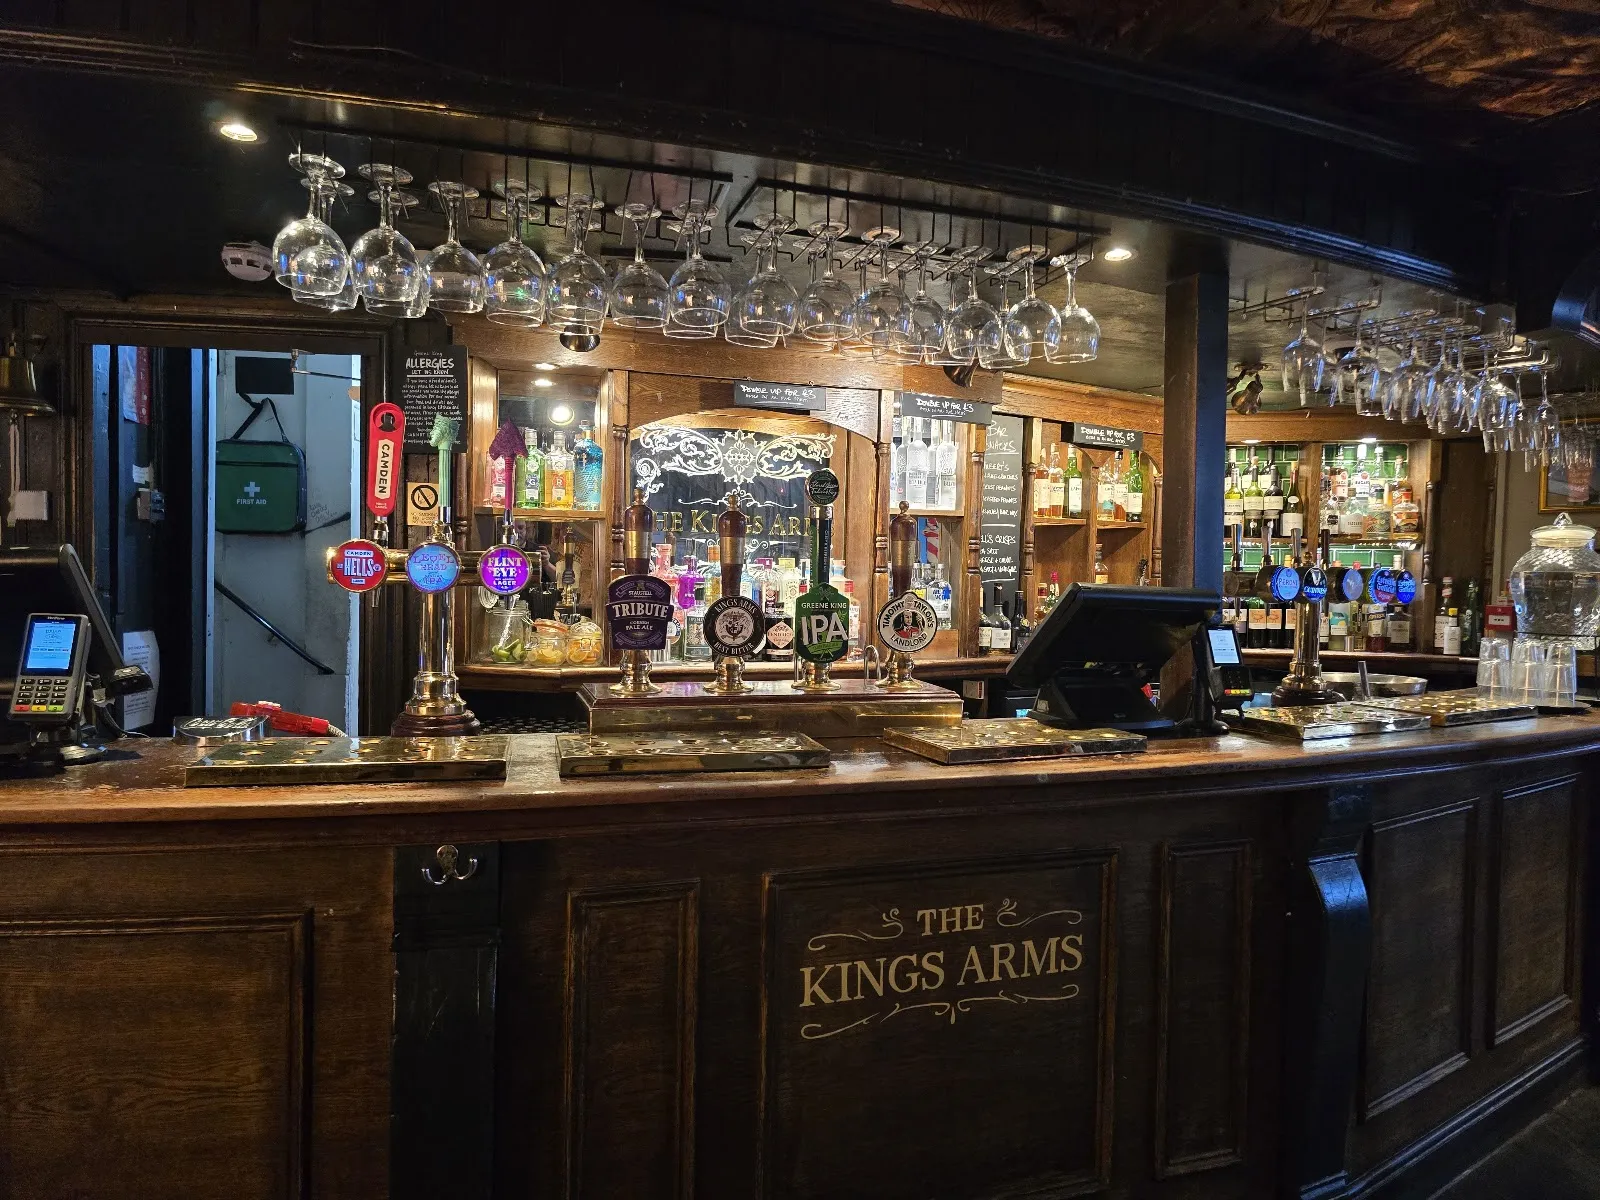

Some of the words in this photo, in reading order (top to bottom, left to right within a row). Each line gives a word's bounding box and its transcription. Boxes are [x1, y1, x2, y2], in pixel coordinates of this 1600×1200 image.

[405, 358, 454, 370] ALLERGIES
[784, 388, 800, 397] FOR
[802, 388, 816, 399] £3
[915, 398, 940, 407] DOUBLE
[942, 401, 950, 409] UP
[950, 402, 961, 411] FOR
[986, 420, 1008, 437] BAR
[1080, 426, 1105, 437] DOUBLE
[1106, 429, 1113, 437] UP
[1114, 430, 1125, 440] FOR
[378, 443, 390, 494] CAMDEN
[653, 510, 683, 533] HE
[690, 509, 764, 535] KIGS
[344, 557, 374, 577] HELLS
[421, 563, 447, 571] HEAD
[487, 557, 522, 567] FLINT
[493, 567, 517, 577] EYE
[1279, 578, 1298, 586] PERONI
[612, 602, 669, 618] TRIBUTE
[714, 598, 737, 613] KINGS
[739, 599, 757, 614] ARMS
[883, 600, 905, 628] TIMOTHY
[913, 601, 934, 628] TAYLOR'S
[801, 612, 848, 646] IPA
[890, 632, 927, 646] LANDLORD
[713, 641, 729, 653] BEST
[731, 642, 754, 655] BITTER
[916, 903, 984, 936] THE
[799, 950, 945, 1007] KINGS
[957, 933, 1084, 986] ARMS
